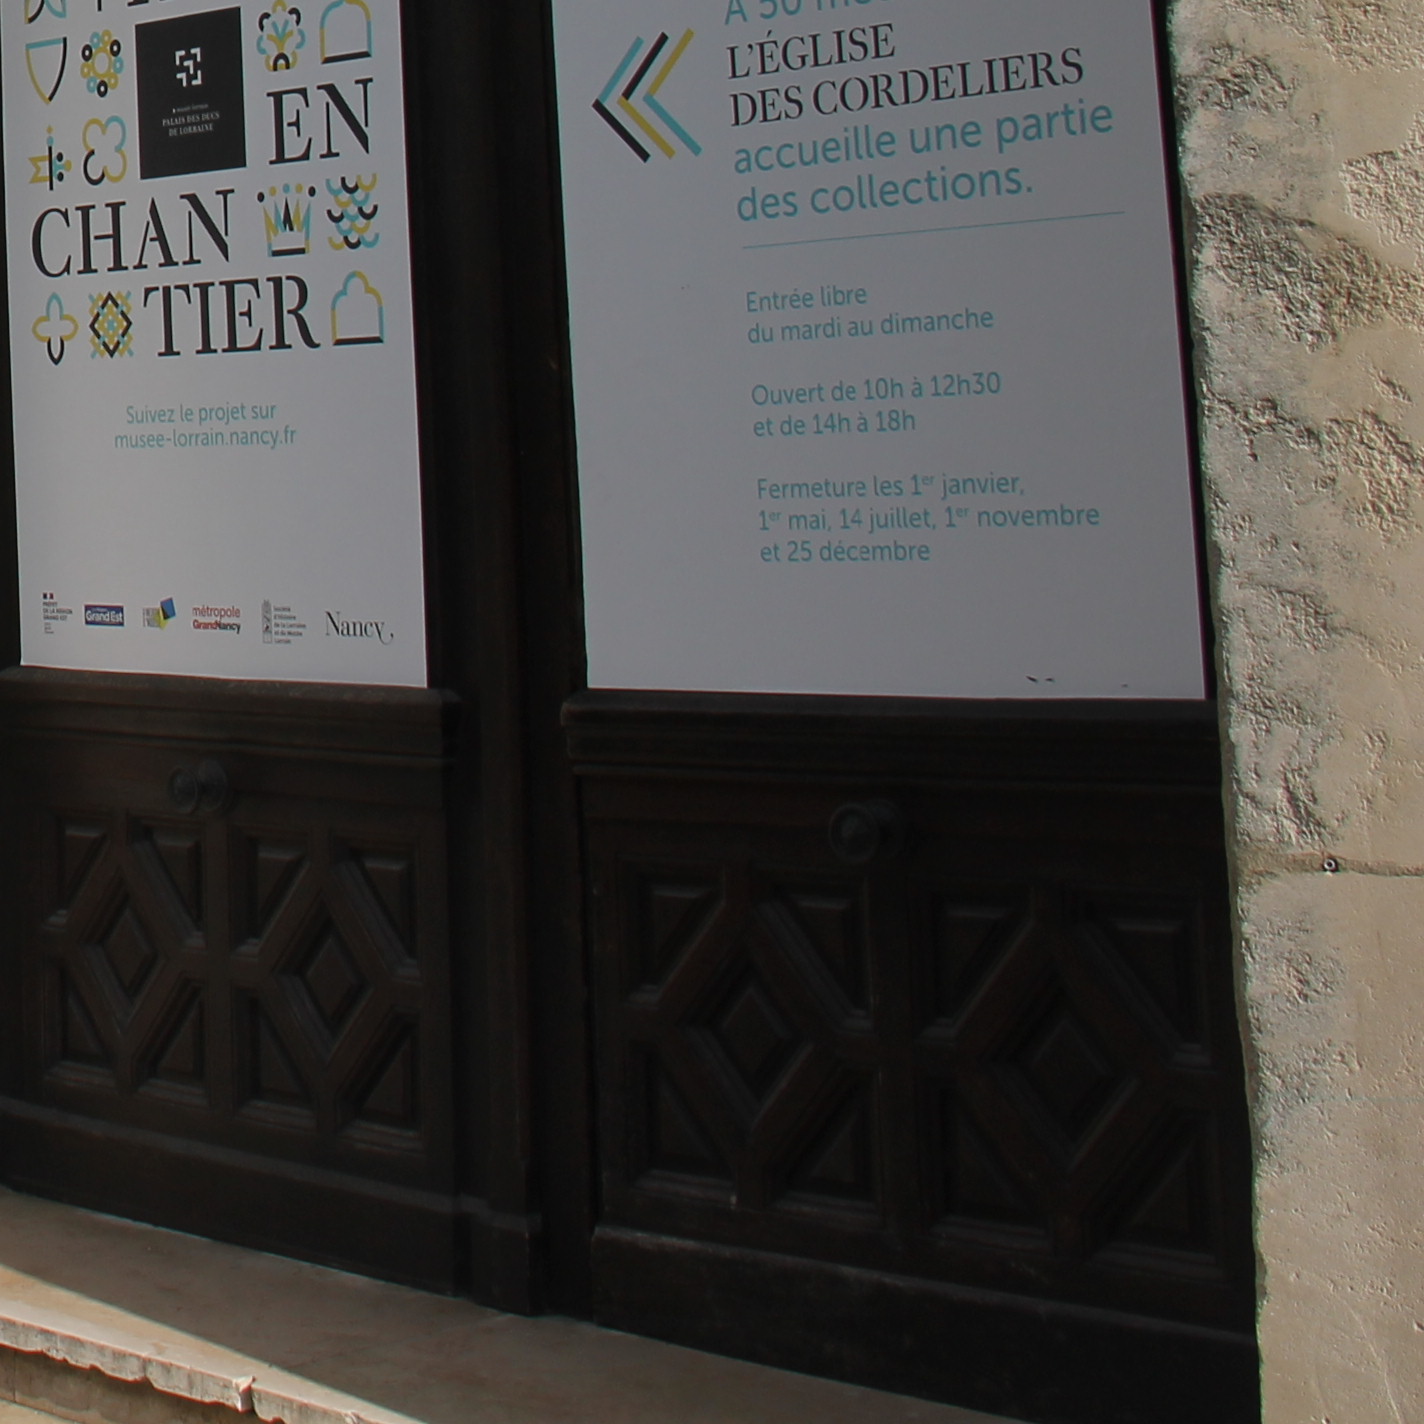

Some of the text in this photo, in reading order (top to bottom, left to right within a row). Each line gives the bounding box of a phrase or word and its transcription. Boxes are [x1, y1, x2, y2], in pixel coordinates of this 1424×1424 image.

[730, 47, 1083, 127] DES CORDELIERS
[267, 78, 374, 165] EN
[734, 98, 1113, 175] accueille une partie
[737, 166, 1033, 221] des collections.
[31, 189, 235, 278] CHAN
[746, 285, 867, 312] Entrée libre
[143, 276, 319, 356] TIER
[748, 308, 994, 344] du mardi au dimanche
[751, 371, 1001, 405] Ouvert de 10h à 12h30
[126, 402, 277, 425] Suivez le projet sur
[753, 410, 916, 437] et de 14h à 18h
[115, 425, 296, 449] musee-lorrain.nancy.fr
[758, 478, 867, 499] Fermeture
[873, 475, 904, 497] les
[941, 471, 1024, 500] janvier,
[788, 509, 832, 531] mai,
[839, 509, 862, 529] 14
[869, 505, 936, 534] juillet,
[977, 504, 1100, 527] novembre
[760, 539, 931, 562] et 25 décembre
[193, 605, 240, 619] métropole
[326, 611, 394, 645] Nancy
